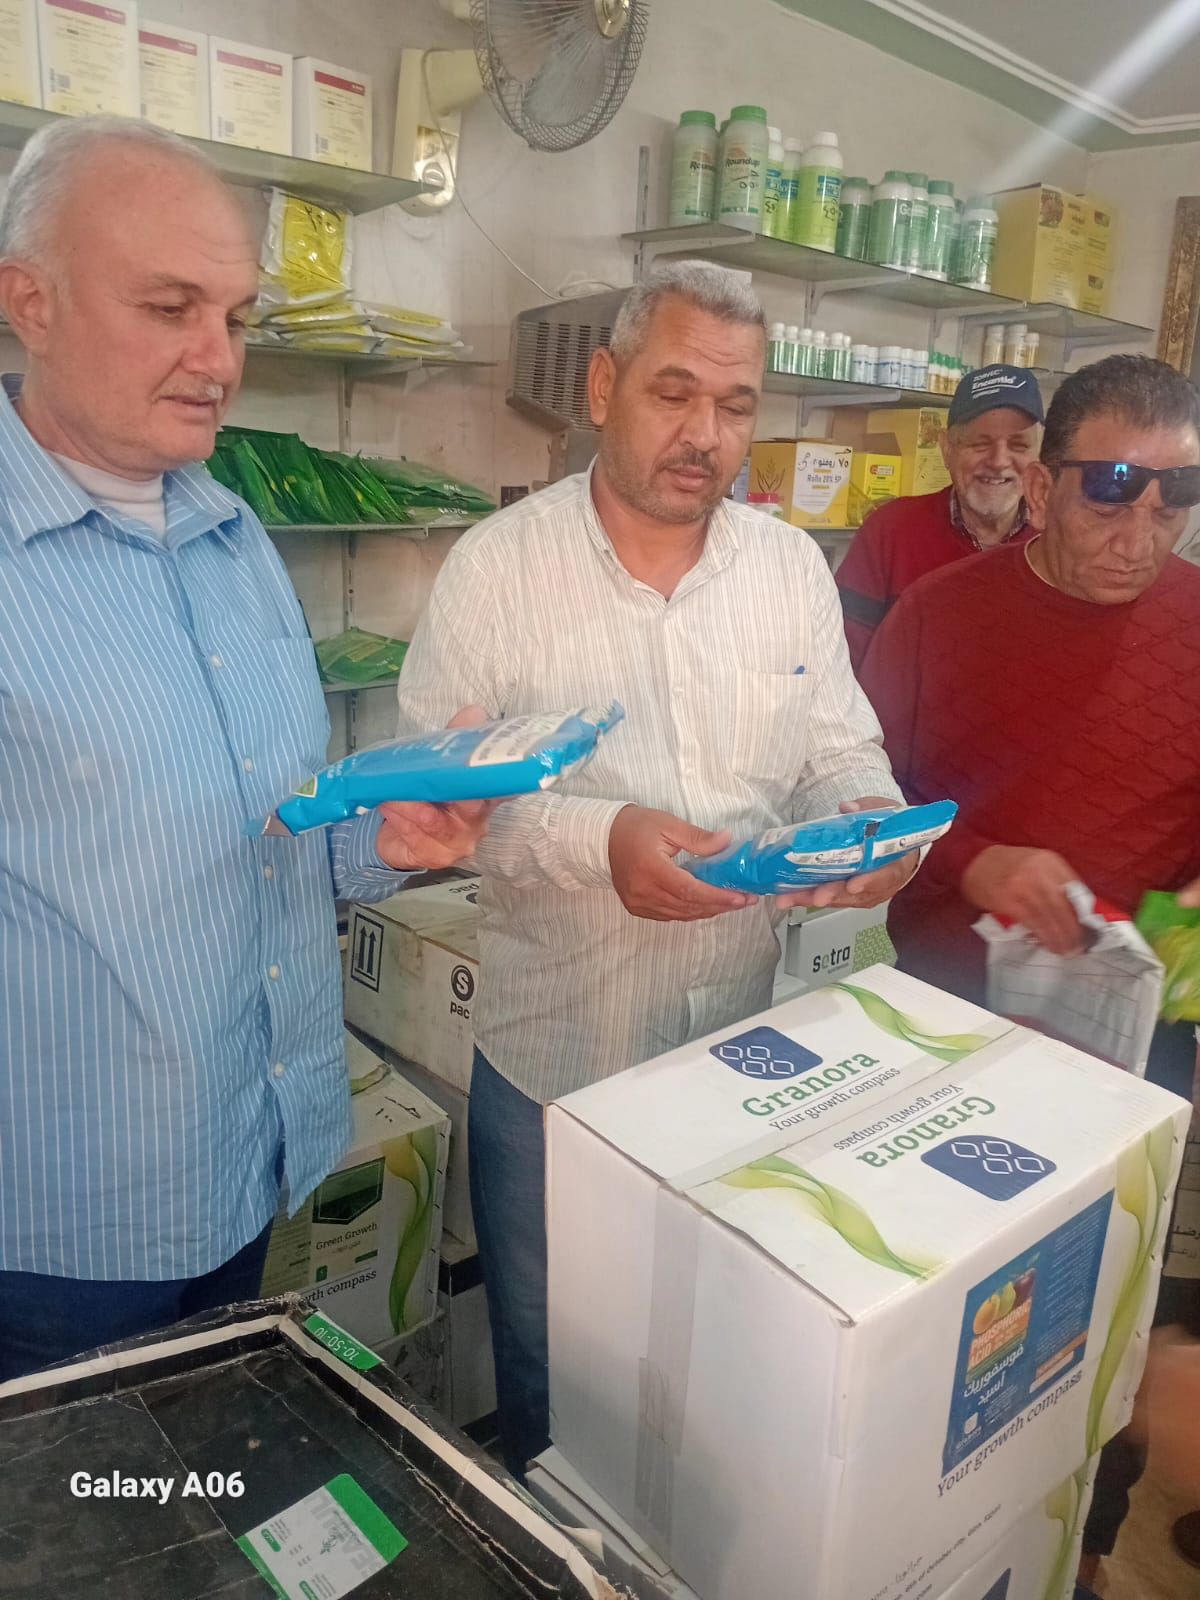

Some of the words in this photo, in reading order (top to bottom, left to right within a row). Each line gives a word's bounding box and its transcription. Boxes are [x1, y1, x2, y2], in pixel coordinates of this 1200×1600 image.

[690, 160, 715, 170] Roun
[726, 157, 760, 167] Roundup
[812, 946, 851, 973] setra
[450, 1001, 470, 1020] pac
[742, 1052, 880, 1117] Granora
[769, 1111, 806, 1131] Your
[804, 1091, 850, 1119] growth
[848, 1066, 901, 1096] compass
[931, 1084, 964, 1103] Your
[888, 1096, 933, 1125] growth
[834, 1119, 889, 1151] compass
[856, 1095, 996, 1168] Granora
[315, 1235, 343, 1250] Green
[344, 1221, 378, 1240] Growth
[327, 1270, 377, 1295] compass
[964, 1343, 1025, 1397] فوسفوريك
[937, 1459, 972, 1498] Your
[973, 1416, 1024, 1472] growth
[1026, 1369, 1083, 1422] compass
